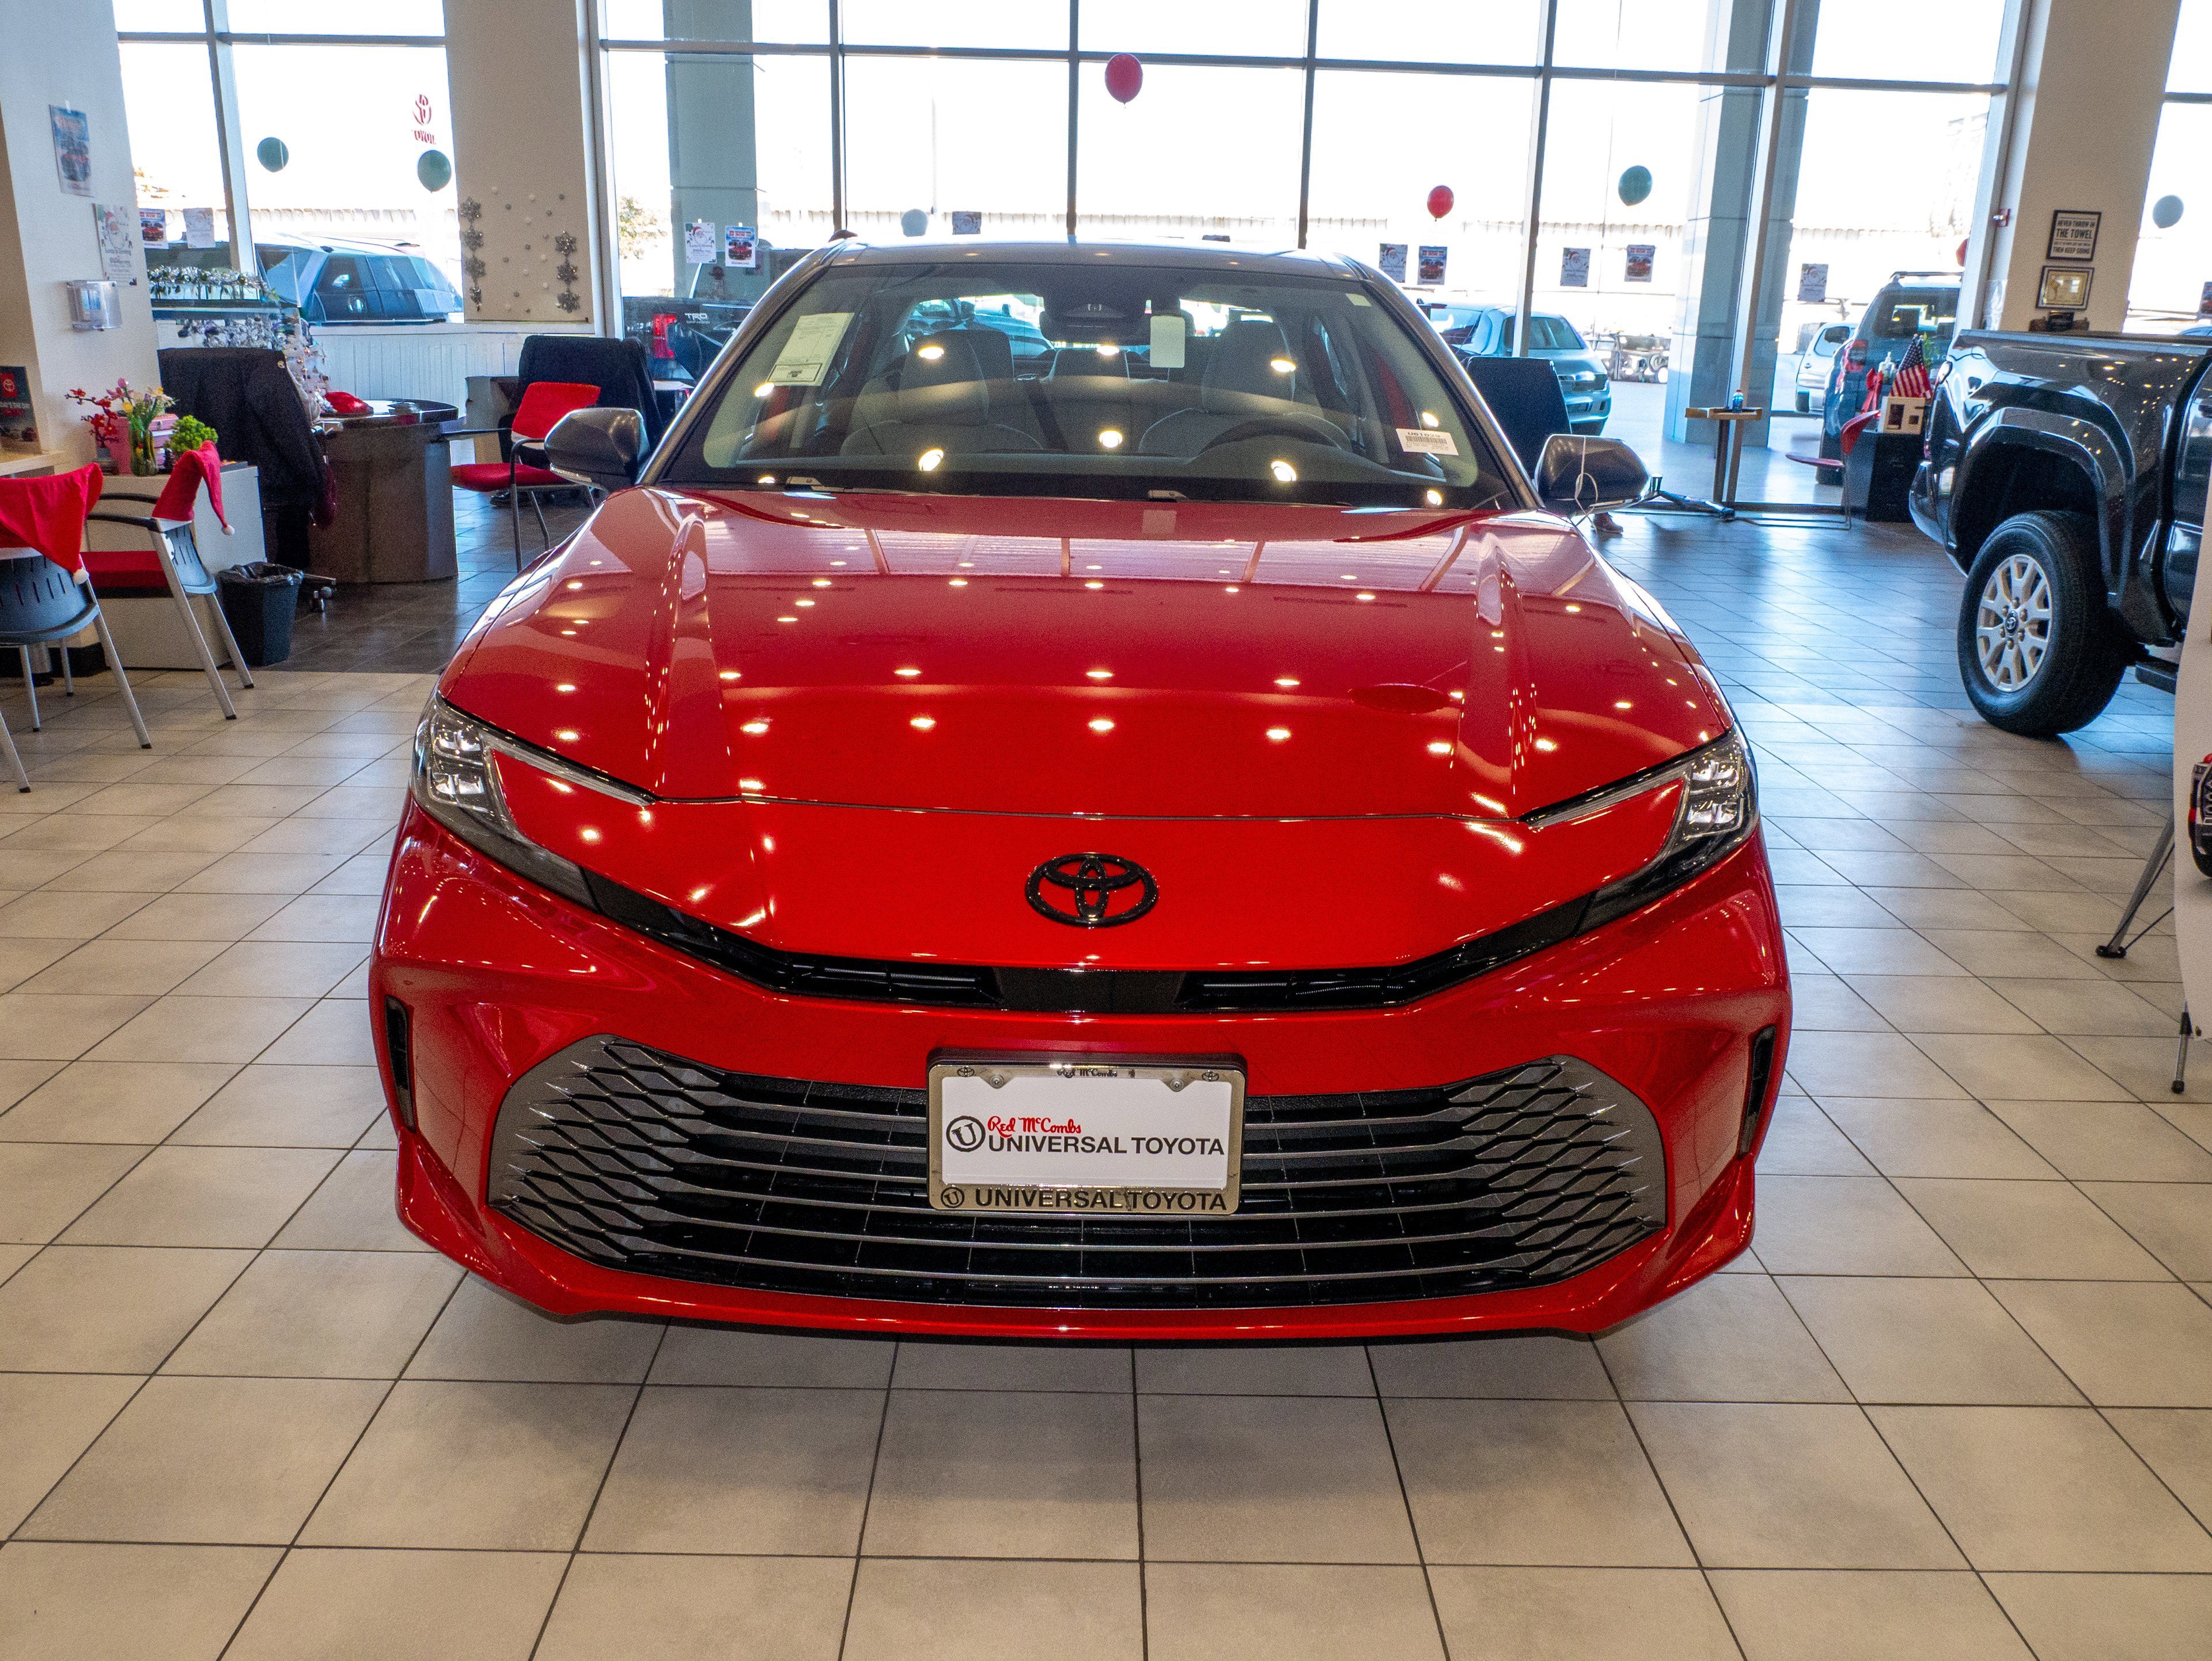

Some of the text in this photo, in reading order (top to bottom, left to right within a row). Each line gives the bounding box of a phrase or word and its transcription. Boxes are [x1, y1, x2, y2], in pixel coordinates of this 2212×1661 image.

[2056, 228, 2092, 239] THE TOWEL
[987, 1116, 1081, 1138] Red McCombs
[989, 1135, 1225, 1155] UNIVERSAL TOYOTA
[975, 1188, 1227, 1210] UNIVERSAL TOYOTA
